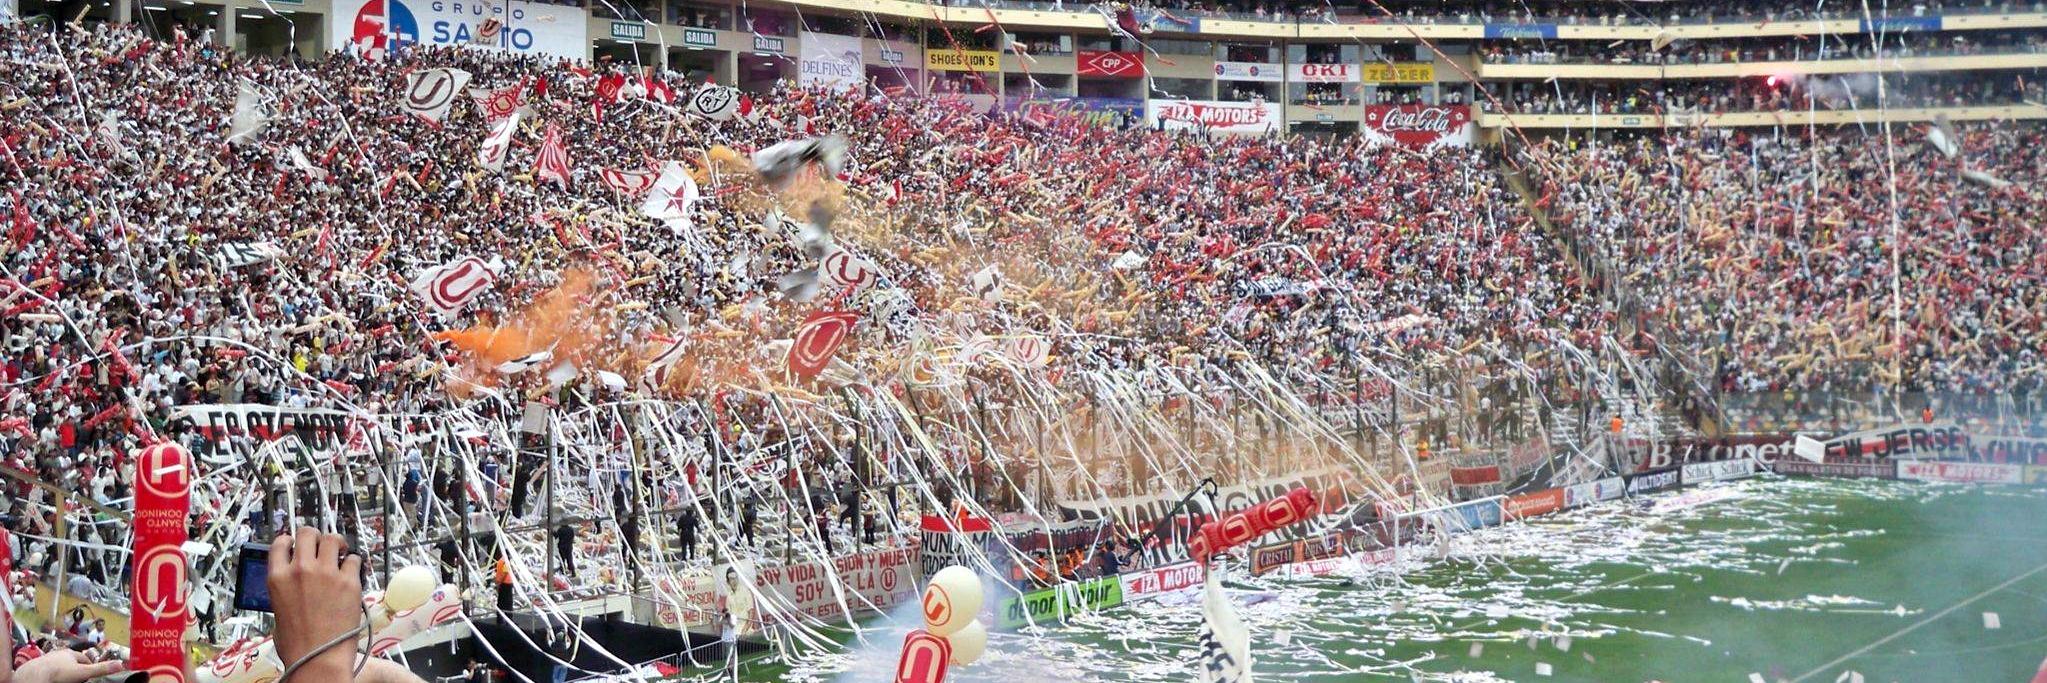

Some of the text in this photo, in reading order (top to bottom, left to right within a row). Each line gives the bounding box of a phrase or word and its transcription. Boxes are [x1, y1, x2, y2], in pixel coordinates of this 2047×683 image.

[433, 21, 533, 50] SATO
[613, 23, 644, 38] SALIDA
[686, 31, 714, 45] SALIDA
[755, 38, 783, 51] SALIDA
[931, 54, 961, 65] SHOES
[1102, 58, 1121, 68] CPP
[803, 60, 852, 77] DELFINES
[1302, 64, 1348, 76] OKI
[1200, 107, 1258, 123] MOTORS
[1825, 435, 1862, 459] EW
[147, 519, 182, 528] SANTO
[757, 567, 781, 587] SOY
[786, 564, 816, 584] VIDA
[821, 555, 864, 578] PSION
[867, 554, 876, 569] Y
[1164, 564, 1205, 589] MOTOR
[795, 581, 825, 603] SOY
[857, 573, 875, 591] LA
[1066, 583, 1113, 610] por
[818, 600, 853, 617] ESTUE
[142, 639, 178, 648] SANTO
